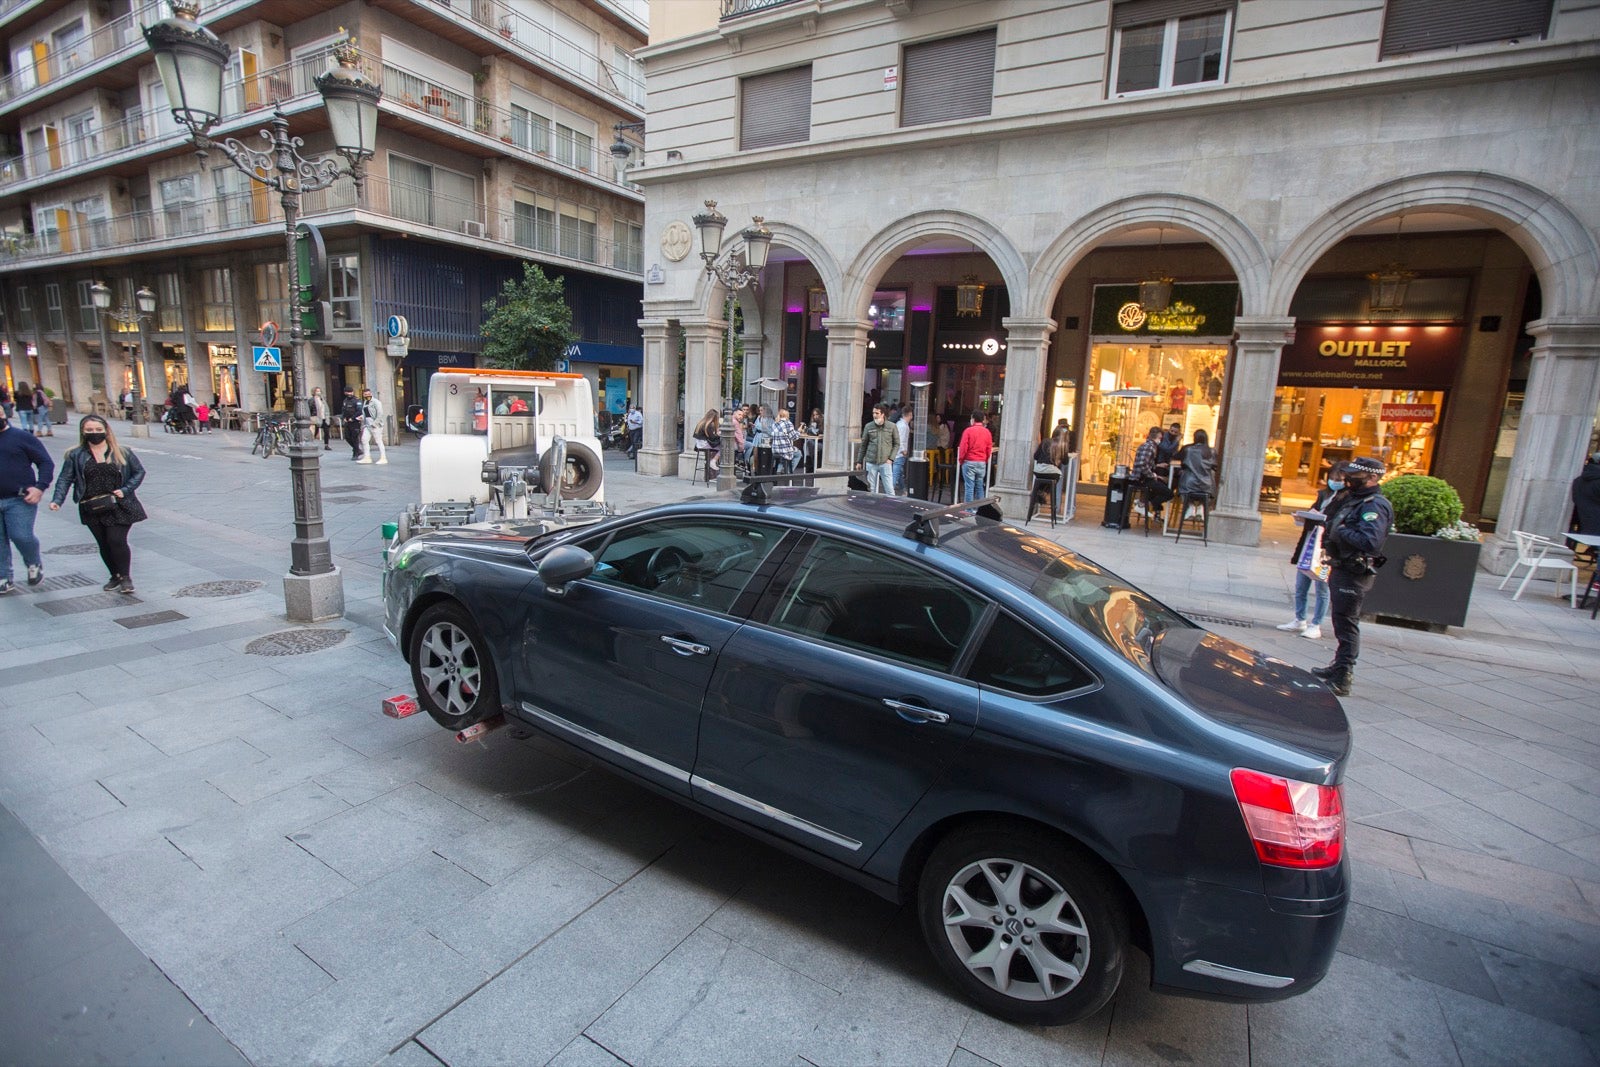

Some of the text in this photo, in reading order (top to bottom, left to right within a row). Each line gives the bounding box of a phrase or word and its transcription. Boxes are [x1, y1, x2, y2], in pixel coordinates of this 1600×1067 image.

[1319, 340, 1411, 357] OUTLET
[438, 355, 458, 364] BBVA
[1354, 359, 1407, 368] MALLORCA
[1281, 371, 1384, 380] www.outletmallorca.net
[449, 383, 458, 395] 3
[1382, 405, 1434, 417] LIQUIDACIÓN
